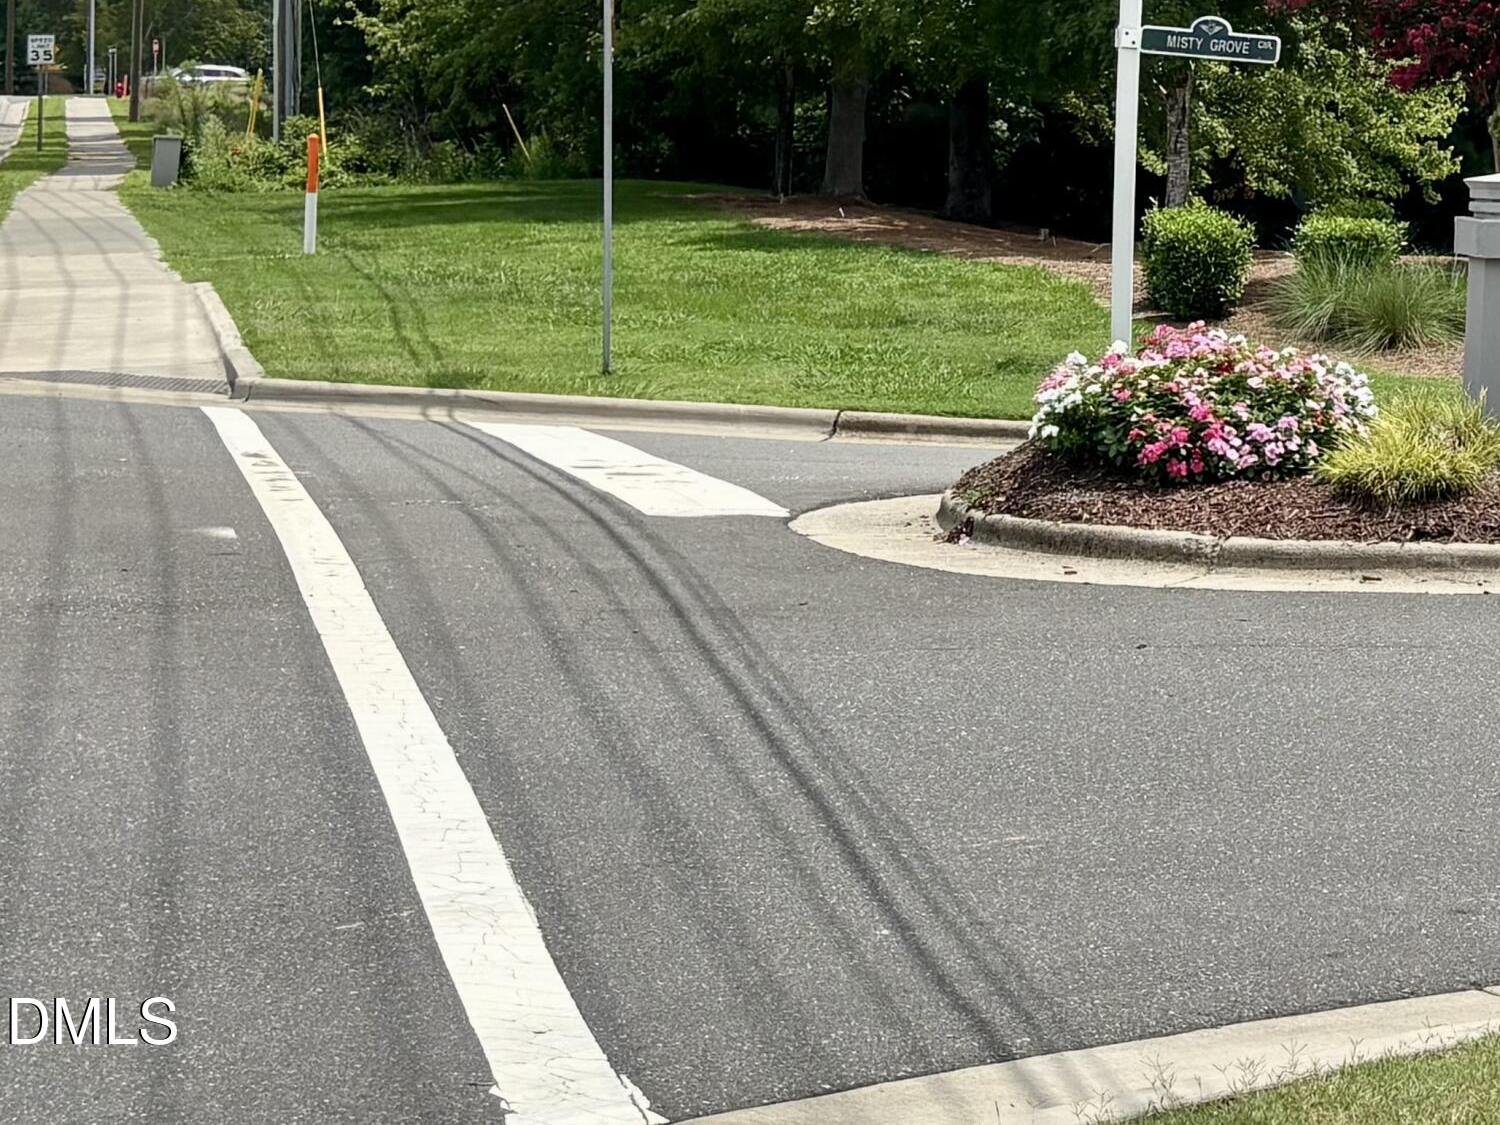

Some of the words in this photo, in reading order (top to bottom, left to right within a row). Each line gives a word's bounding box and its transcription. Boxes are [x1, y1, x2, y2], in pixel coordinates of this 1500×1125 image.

[1167, 35, 1203, 50] MISTY
[1210, 39, 1250, 54] GROVE
[31, 50, 52, 61] 35
